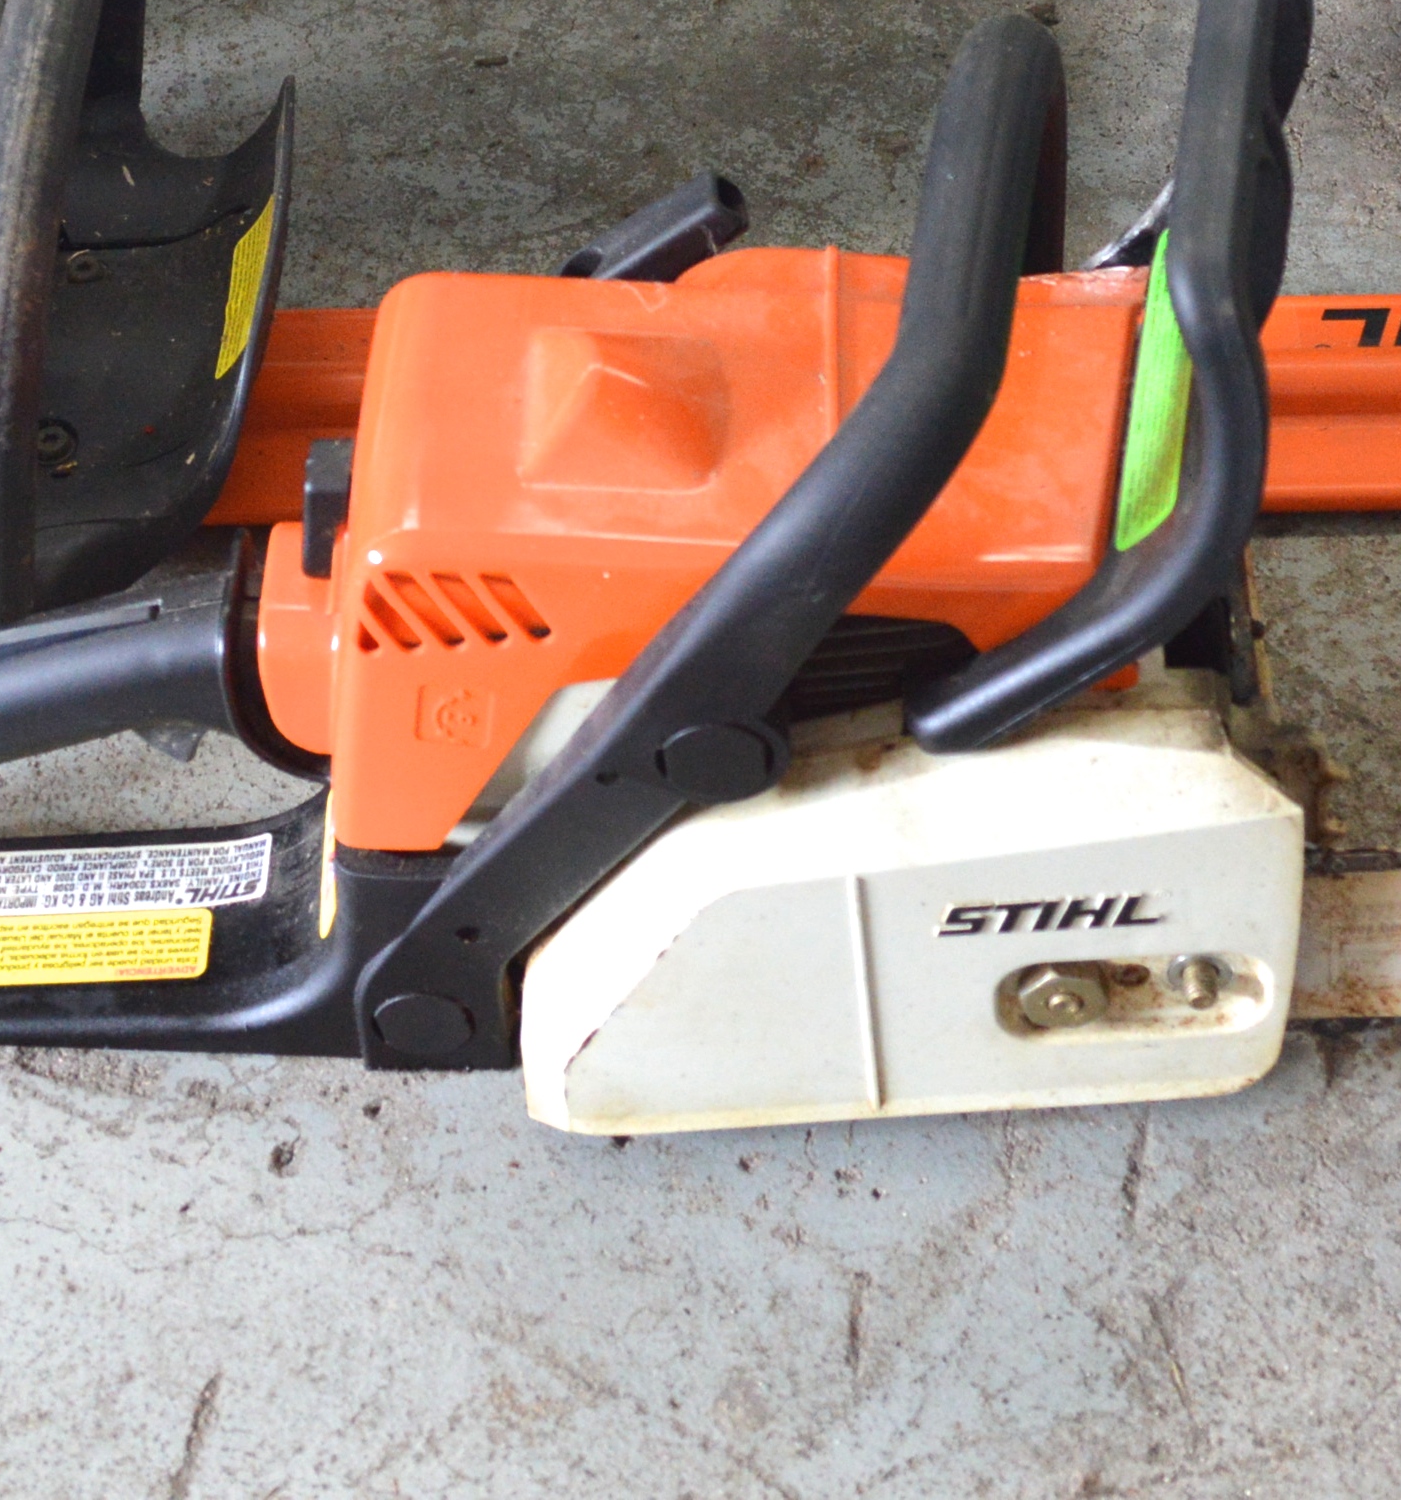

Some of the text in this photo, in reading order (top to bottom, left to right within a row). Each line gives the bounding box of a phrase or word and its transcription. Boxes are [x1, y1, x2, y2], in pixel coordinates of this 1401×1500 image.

[212, 846, 230, 854] FOR
[233, 838, 267, 853] MANUAL
[8, 853, 66, 864] ADJUSTMENT
[188, 857, 205, 865] FOR
[207, 848, 265, 865] REGULATIONS
[81, 859, 137, 870] COMPLIANCE
[210, 863, 243, 875] ENGINE
[245, 859, 263, 870] THIS
[76, 871, 95, 881] AND
[107, 870, 136, 879] PHASE
[138, 869, 155, 879] EPA
[178, 866, 209, 876] MEETS
[228, 868, 262, 882] ENGINE
[4, 874, 32, 884] LATER
[33, 873, 52, 882] AND
[77, 893, 86, 907] &
[88, 892, 104, 906] AG
[106, 891, 131, 906] Stihl
[133, 889, 175, 904] Andreas
[72, 919, 114, 929] entregan
[132, 918, 150, 926] que
[152, 915, 202, 926] Seguridad
[31, 923, 69, 932] escritos
[147, 928, 172, 936] tener
[30, 934, 44, 942] del
[48, 932, 82, 941] Manual
[96, 930, 129, 938] cuenta
[0, 943, 50, 952] ayudantes
[166, 944, 199, 954] graves
[59, 952, 88, 960] forma
[175, 956, 198, 965] Esta
[41, 959, 87, 970] peligrosa
[106, 958, 138, 967] puede
[139, 957, 173, 966] unidad
